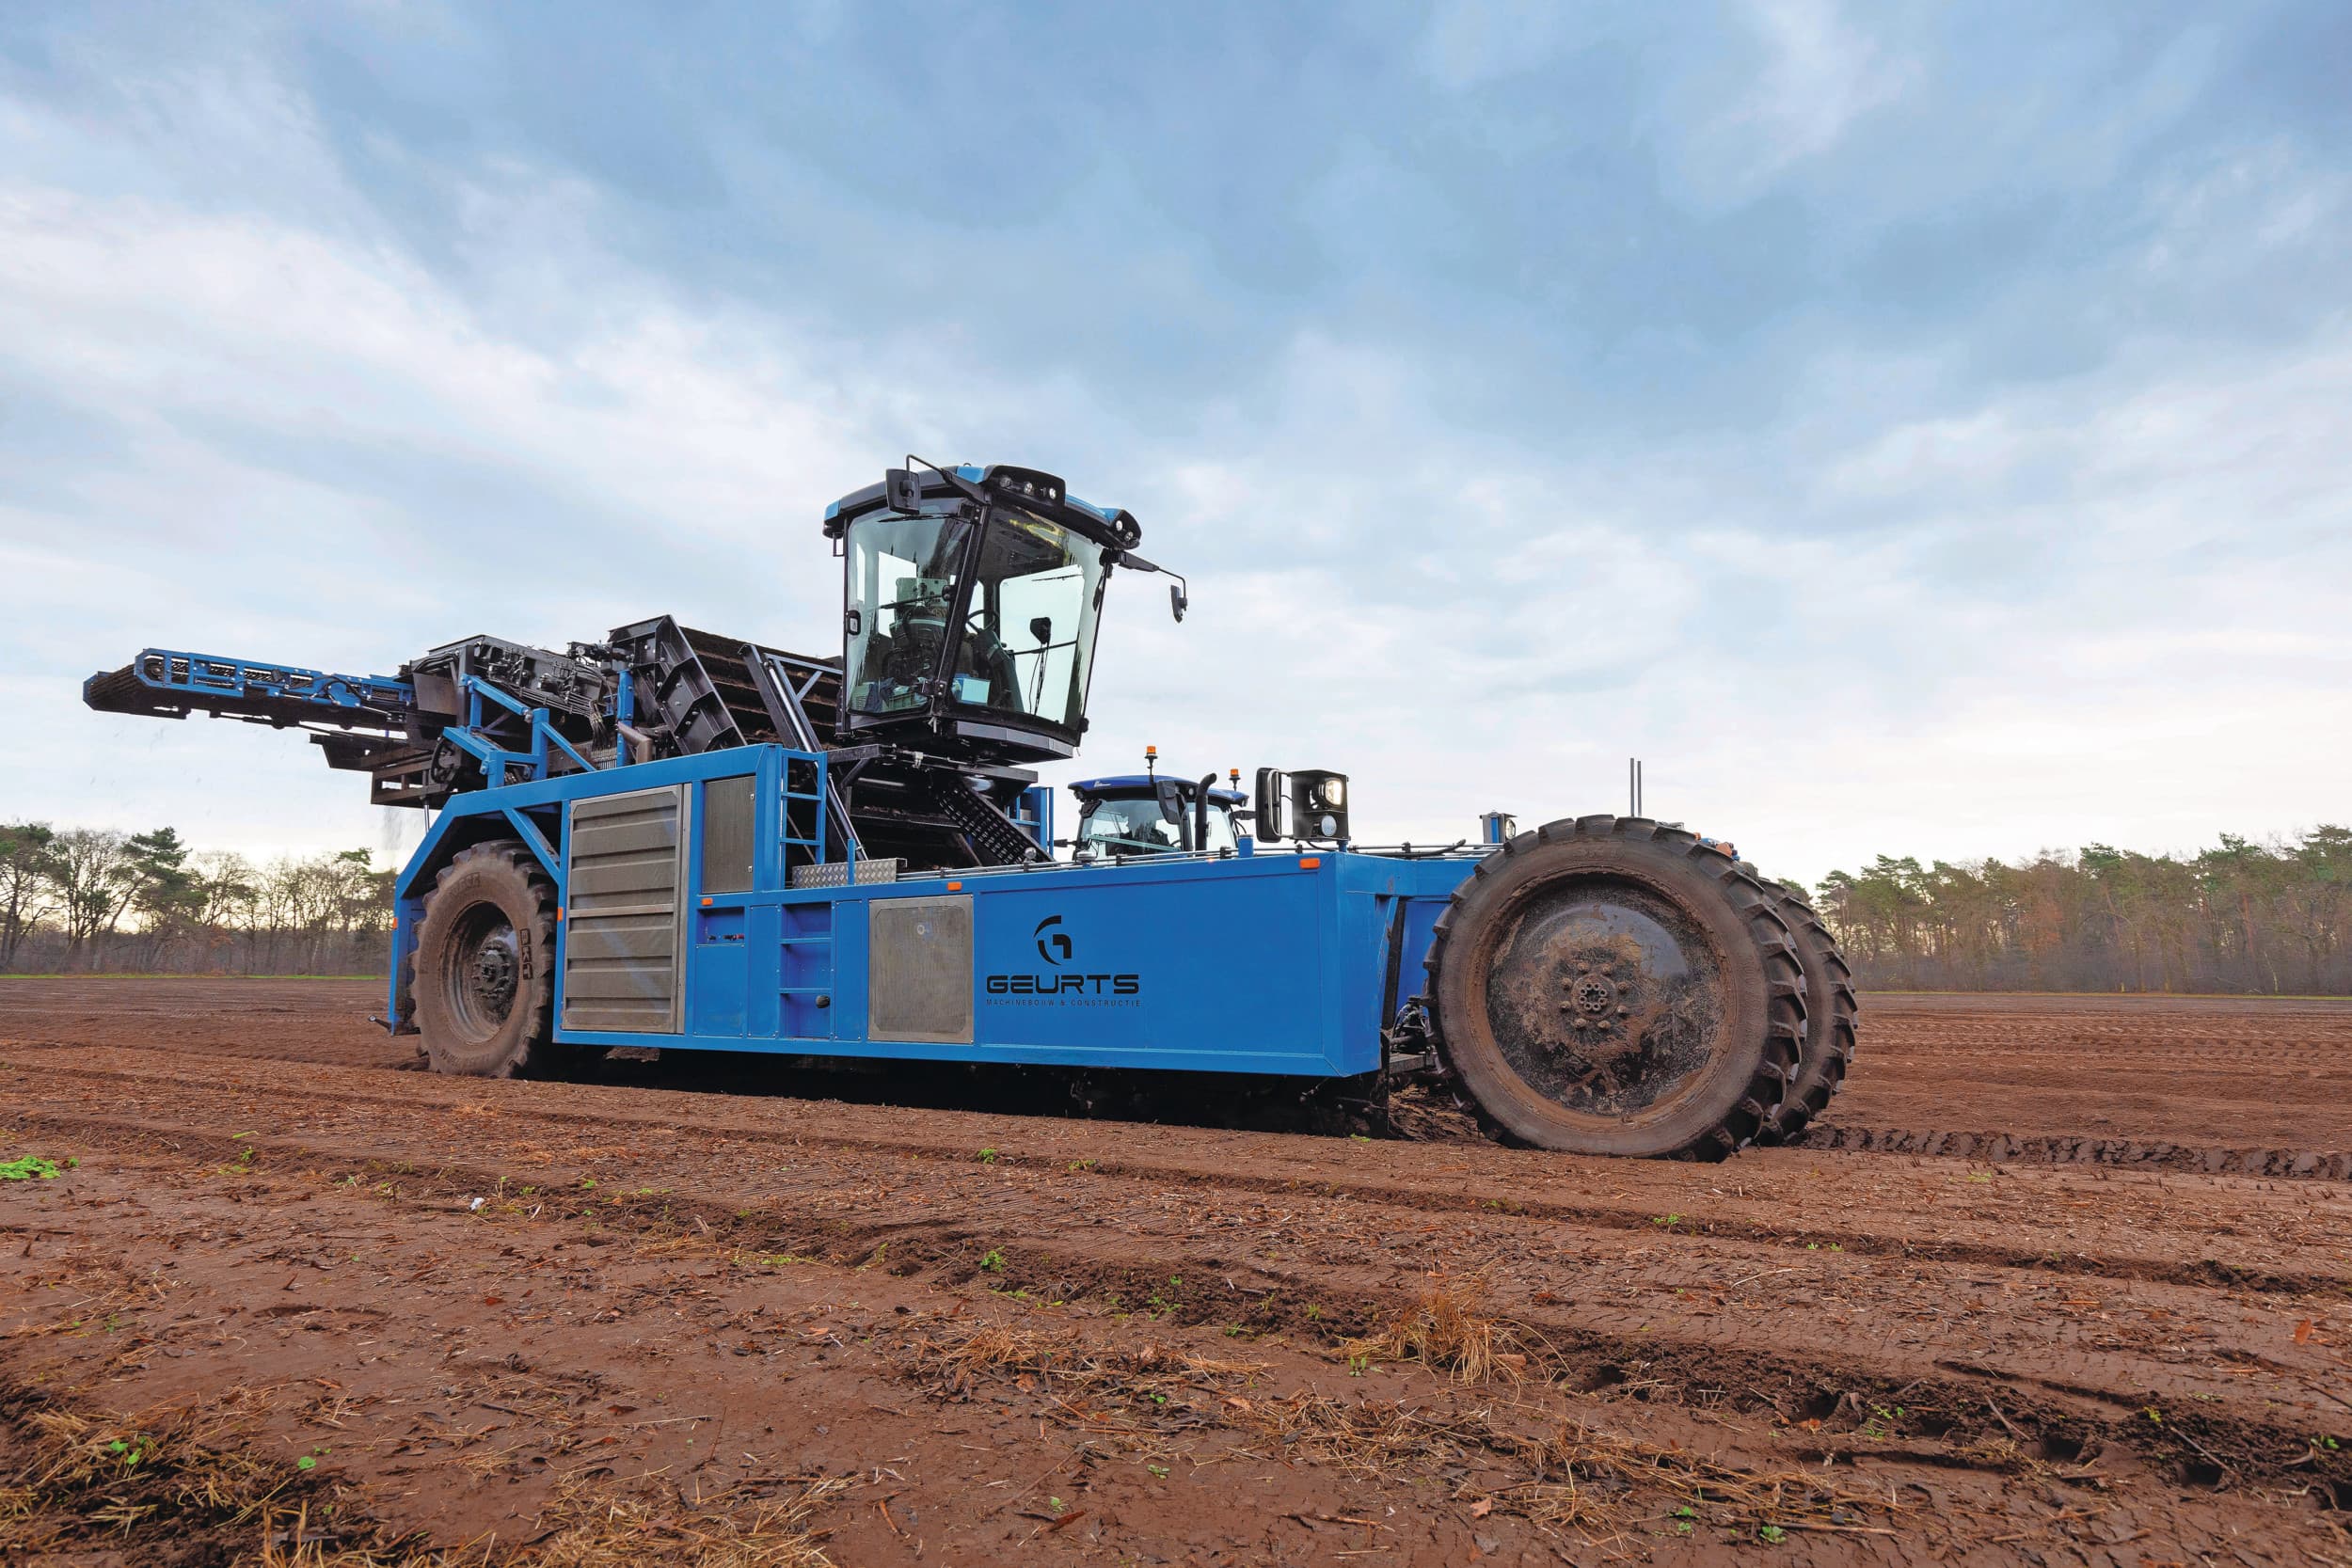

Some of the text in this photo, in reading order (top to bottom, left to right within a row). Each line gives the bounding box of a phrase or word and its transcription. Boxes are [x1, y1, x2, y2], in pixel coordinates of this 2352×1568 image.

[520, 928, 532, 979] BKT
[986, 974, 1139, 994] GEURTS
[986, 998, 1055, 1006] MACHINEBOUW
[1071, 999, 1141, 1007] CONSTRUCTIE
